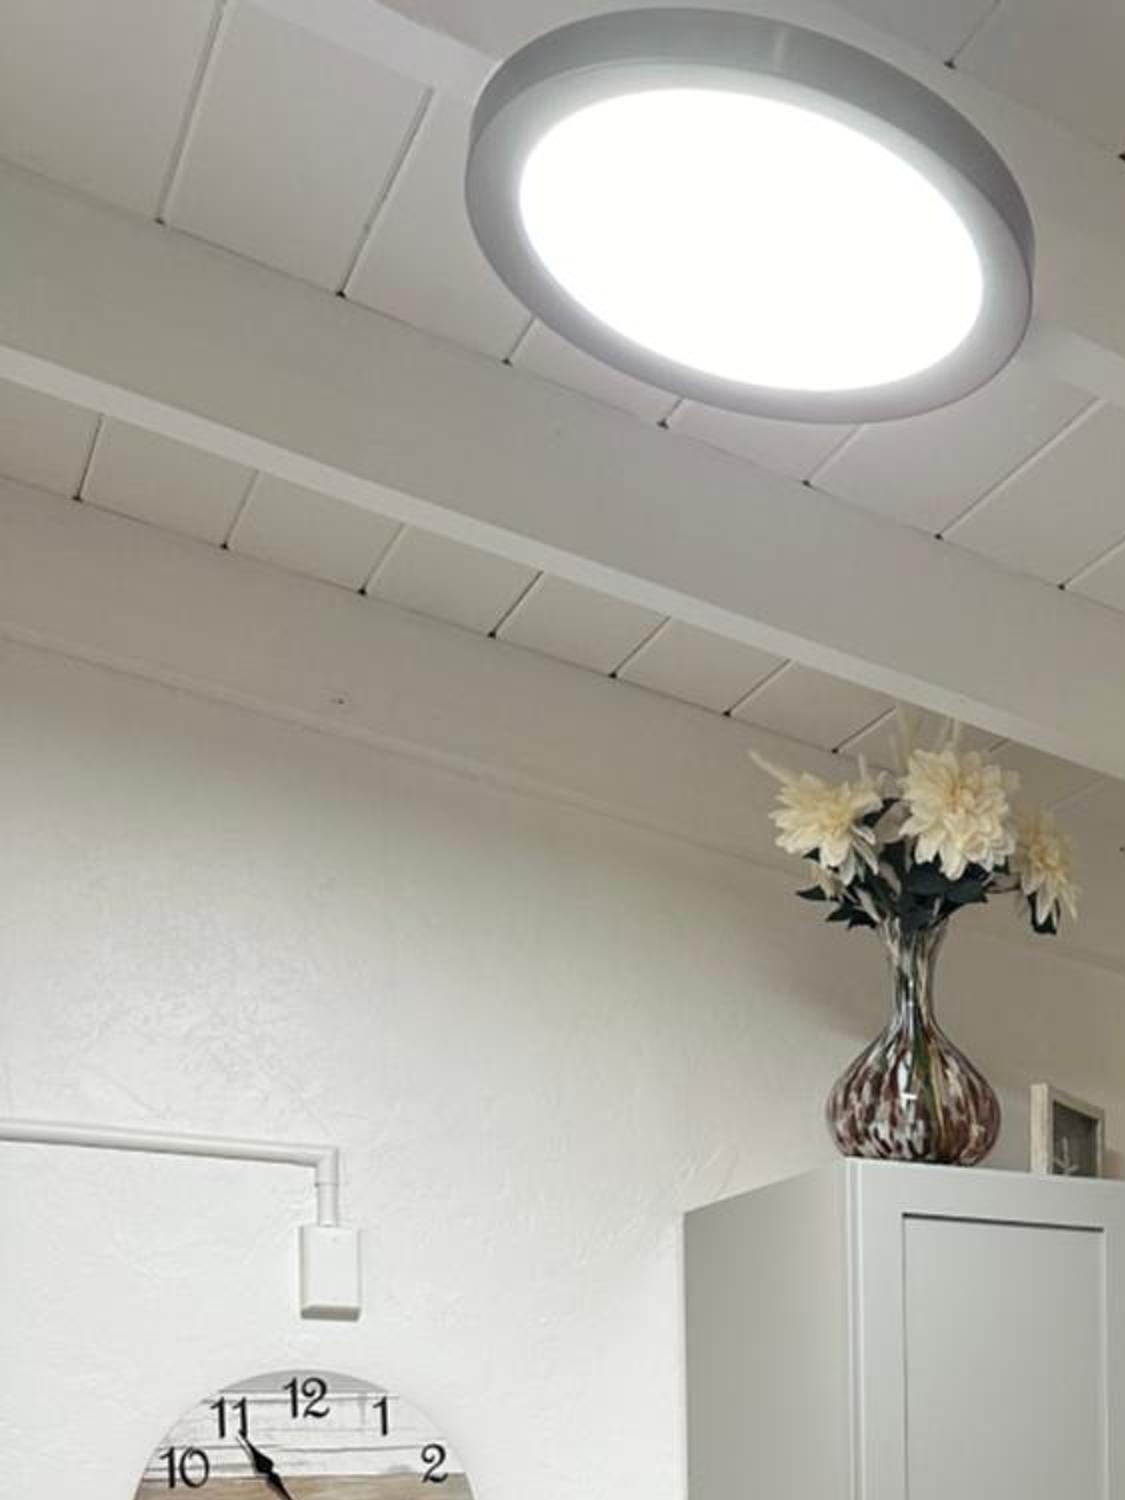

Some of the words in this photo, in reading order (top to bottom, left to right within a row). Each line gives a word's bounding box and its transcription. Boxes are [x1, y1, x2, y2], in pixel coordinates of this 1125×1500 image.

[210, 1397, 248, 1438] 11
[282, 1376, 330, 1419] 12
[373, 1396, 389, 1436] 1
[159, 1446, 210, 1489] 10
[421, 1443, 449, 1484] 2
